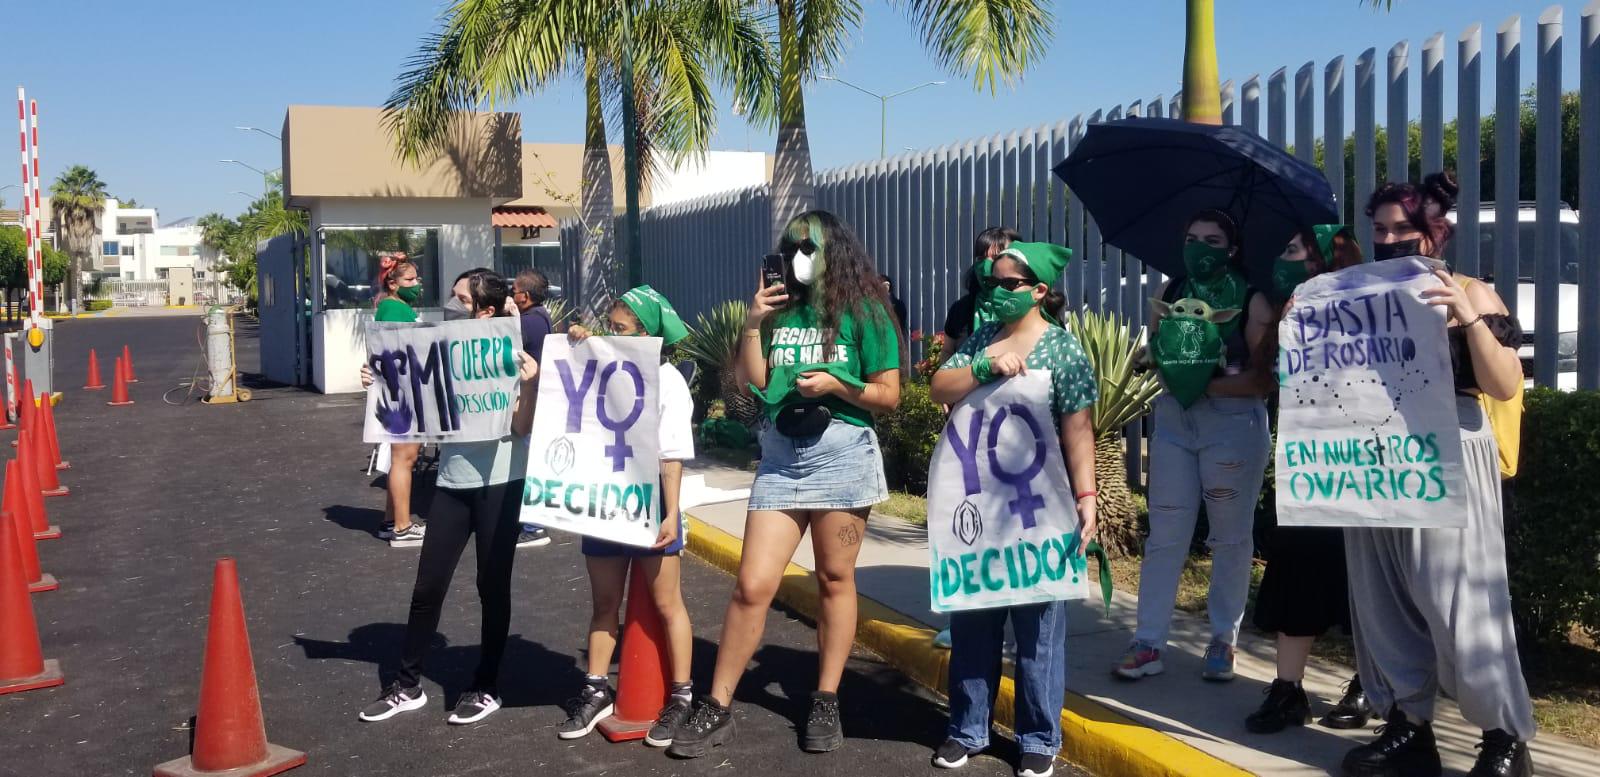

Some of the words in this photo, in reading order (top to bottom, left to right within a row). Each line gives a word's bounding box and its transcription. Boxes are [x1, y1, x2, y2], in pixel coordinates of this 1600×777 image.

[771, 327, 834, 346] ECIDI
[1295, 289, 1409, 344] BASTA
[449, 334, 517, 382] CUERPO
[1286, 344, 1316, 375] DE
[1323, 336, 1417, 370] ROSARIO
[406, 336, 461, 433] MI
[455, 386, 512, 414] DESICIÓN
[553, 359, 645, 473] YO
[946, 402, 1047, 530] YO
[1284, 439, 1317, 468] EN
[1322, 433, 1441, 467] NUESTROS
[523, 476, 655, 528] DECIDO!
[1289, 464, 1448, 503] OVARIOS
